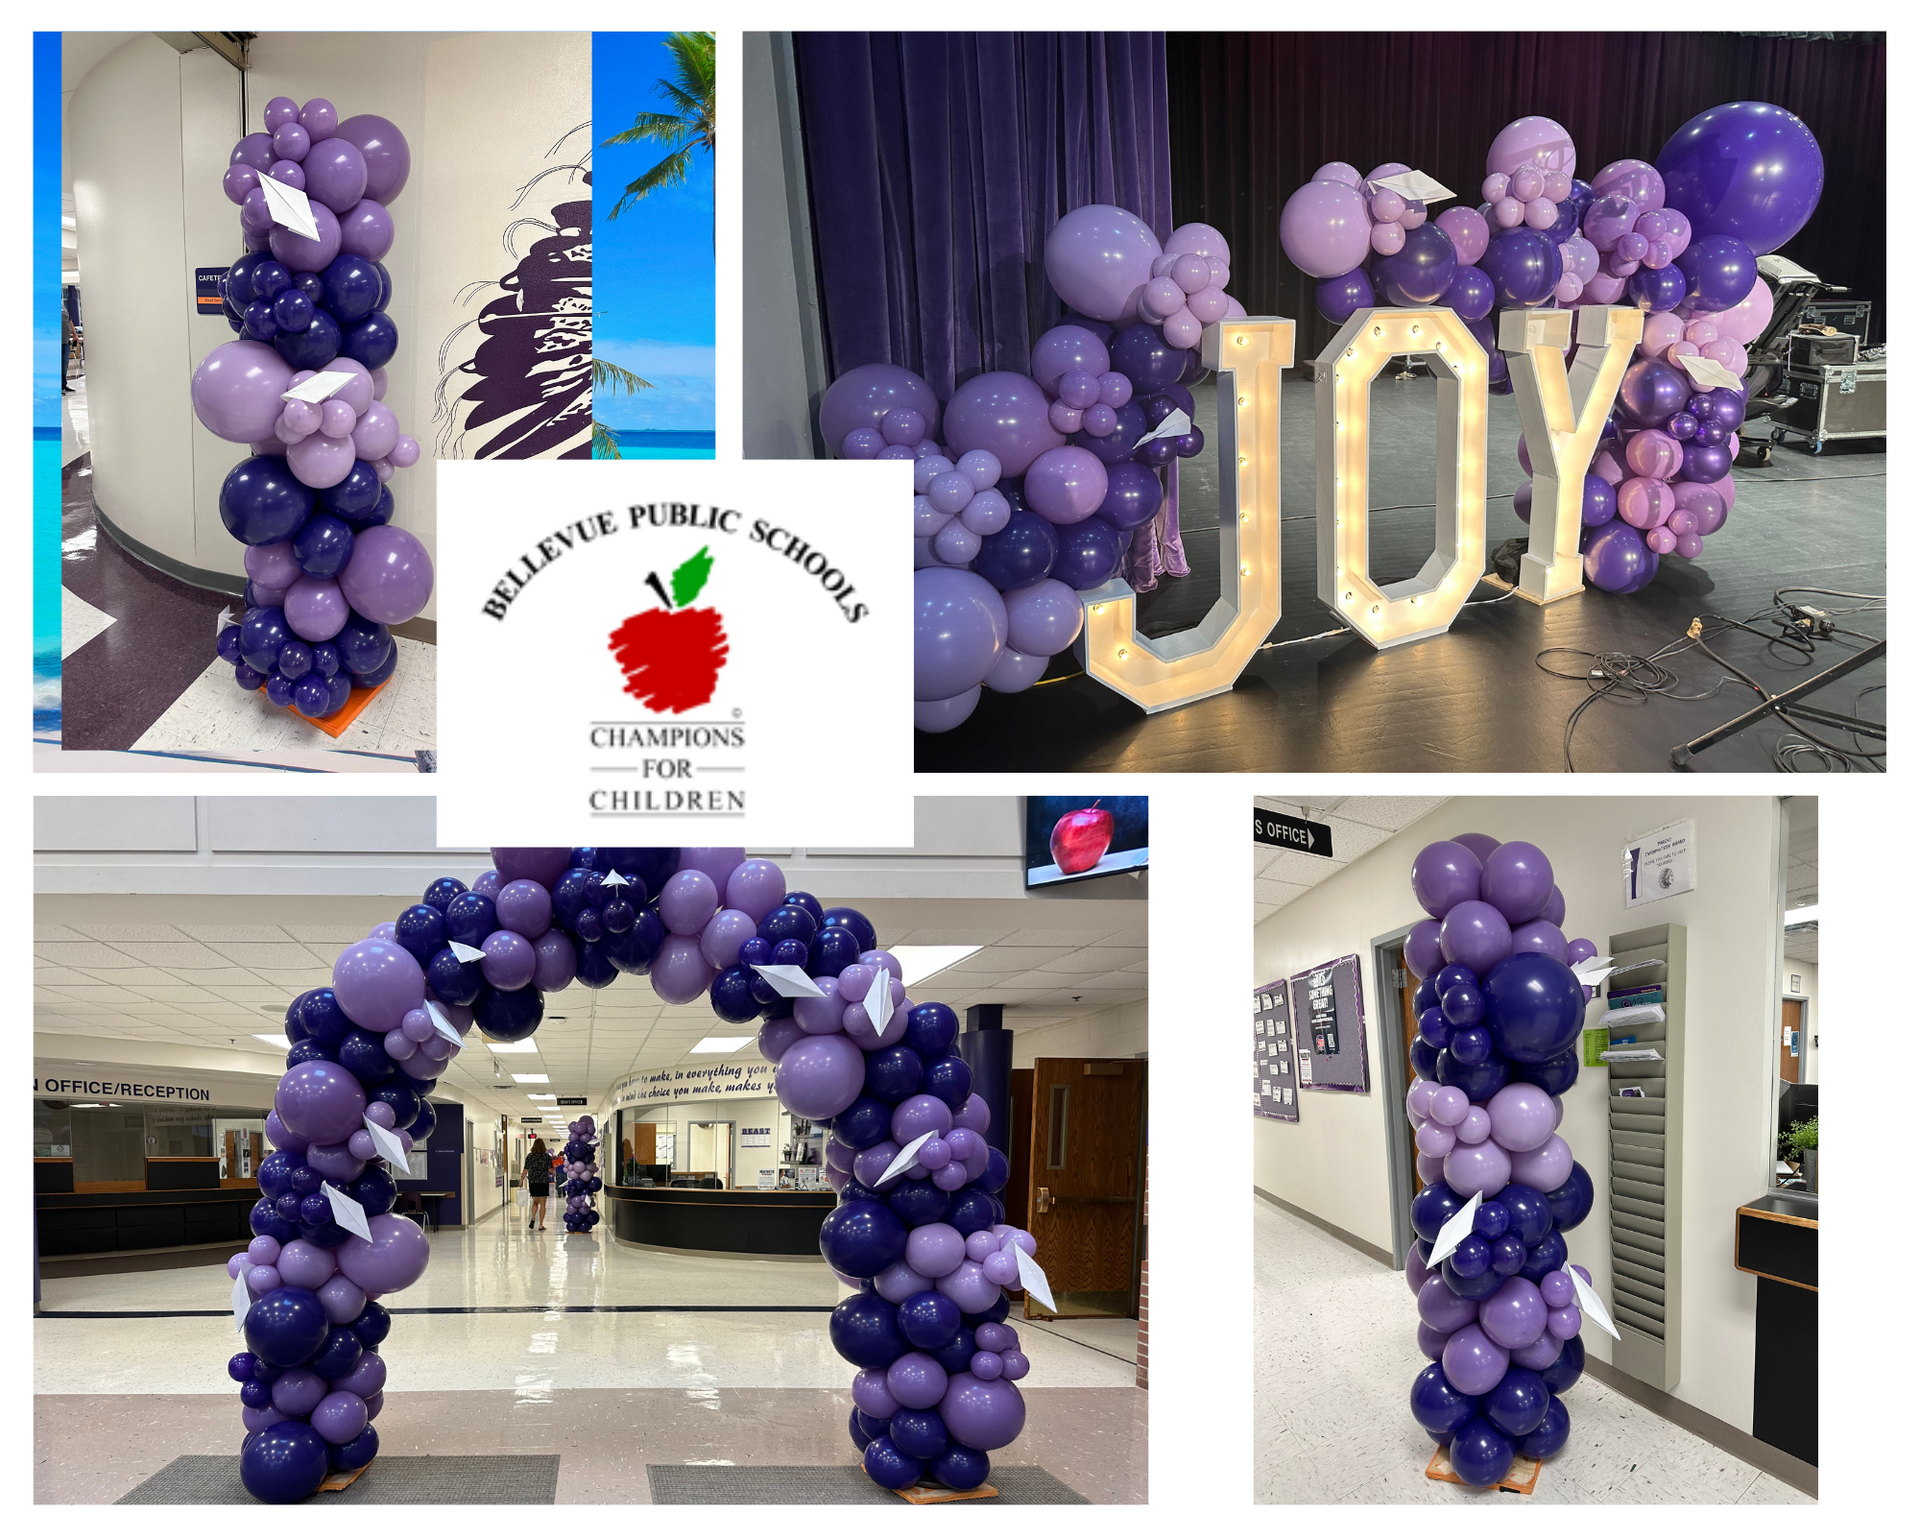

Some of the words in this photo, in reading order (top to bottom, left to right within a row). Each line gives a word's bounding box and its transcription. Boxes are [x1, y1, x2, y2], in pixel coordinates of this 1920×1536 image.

[1083, 305, 1644, 714] JOY
[1255, 819, 1263, 835] S
[1267, 822, 1306, 844] OFFICE
[650, 1070, 672, 1082] make,
[675, 1070, 683, 1080] in
[686, 1064, 742, 1081] everything
[747, 1066, 767, 1078] you
[45, 1078, 210, 1100] OFFICE/RECEPTION
[649, 1086, 670, 1098] choice
[674, 1087, 689, 1099] you
[692, 1081, 722, 1094] make,
[725, 1079, 761, 1092] makes
